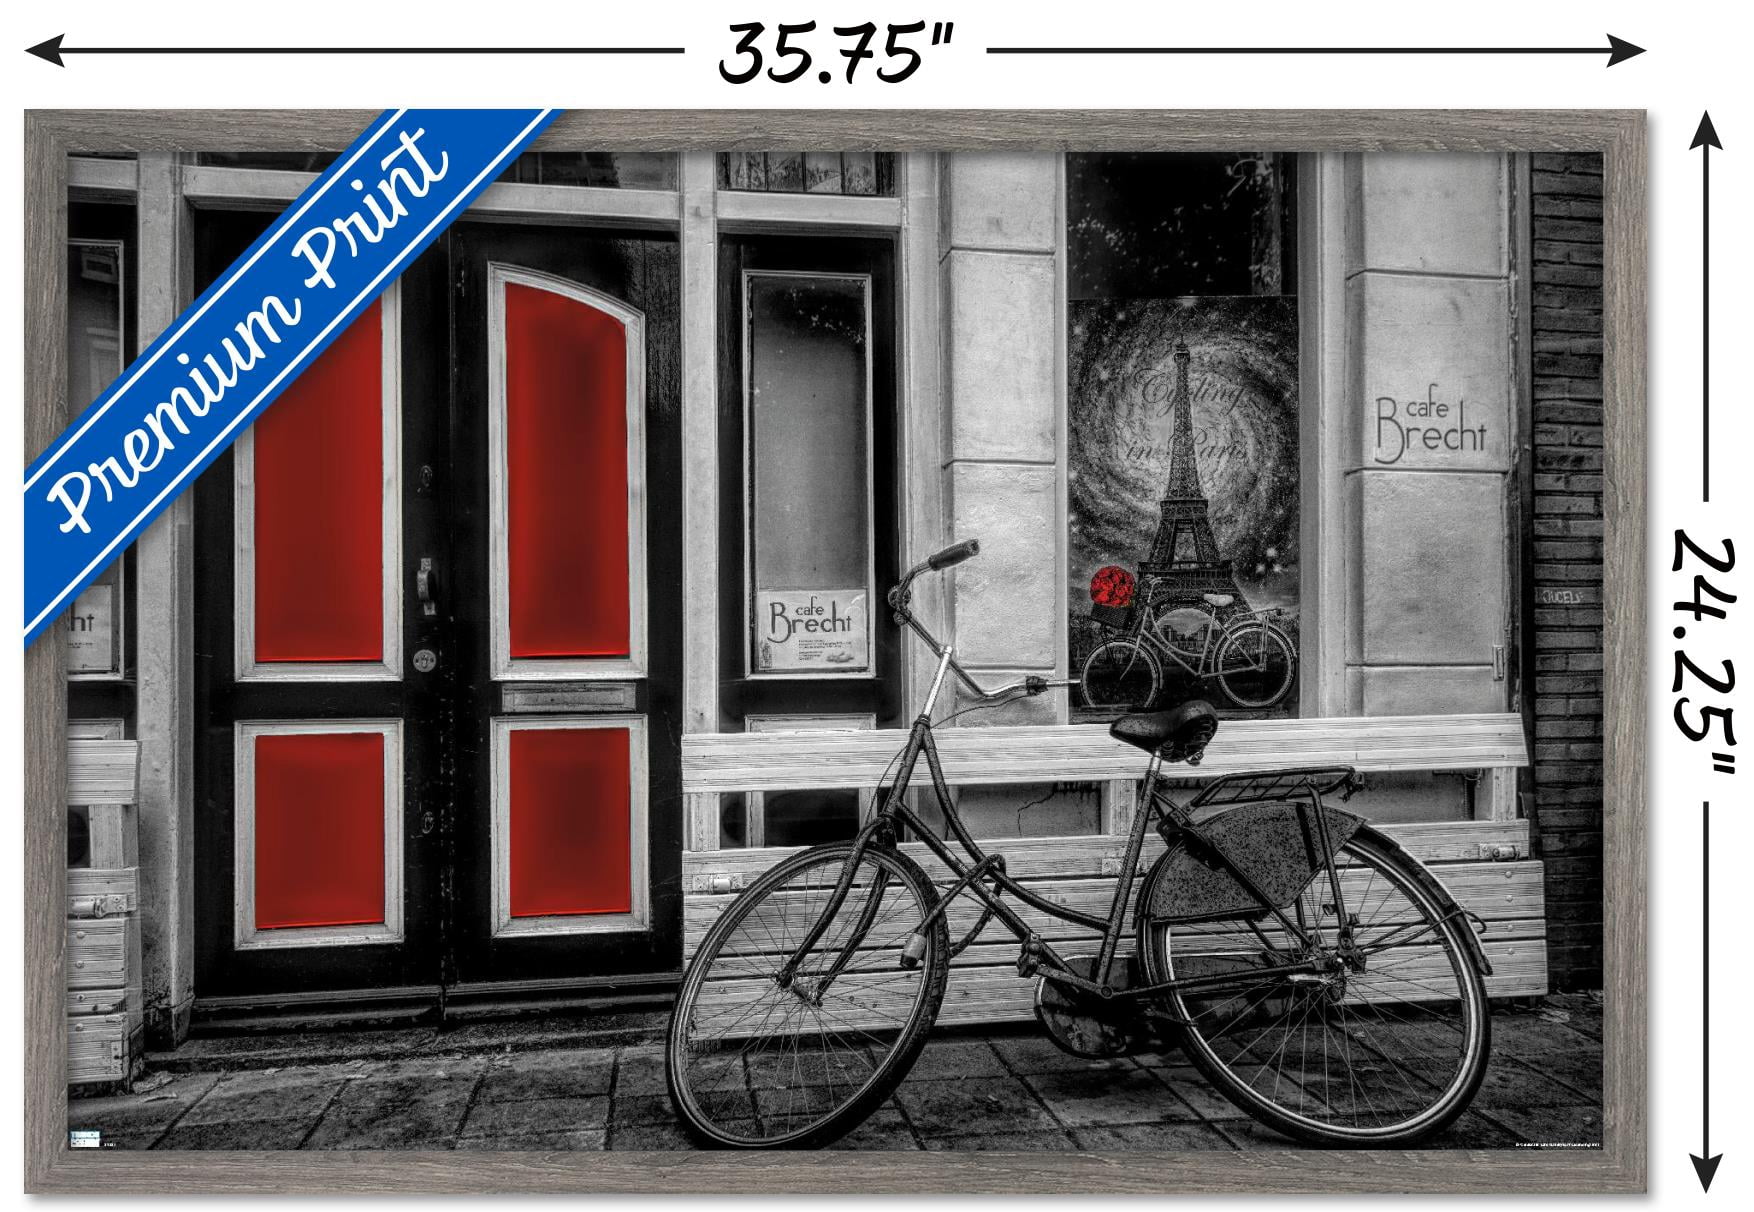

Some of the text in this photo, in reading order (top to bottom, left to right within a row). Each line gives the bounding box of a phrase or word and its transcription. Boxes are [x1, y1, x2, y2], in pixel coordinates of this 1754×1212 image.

[1406, 383, 1449, 418] cafe
[1374, 396, 1487, 465] Brecht
[766, 600, 852, 644] Brecht
[795, 595, 825, 616] cafe
